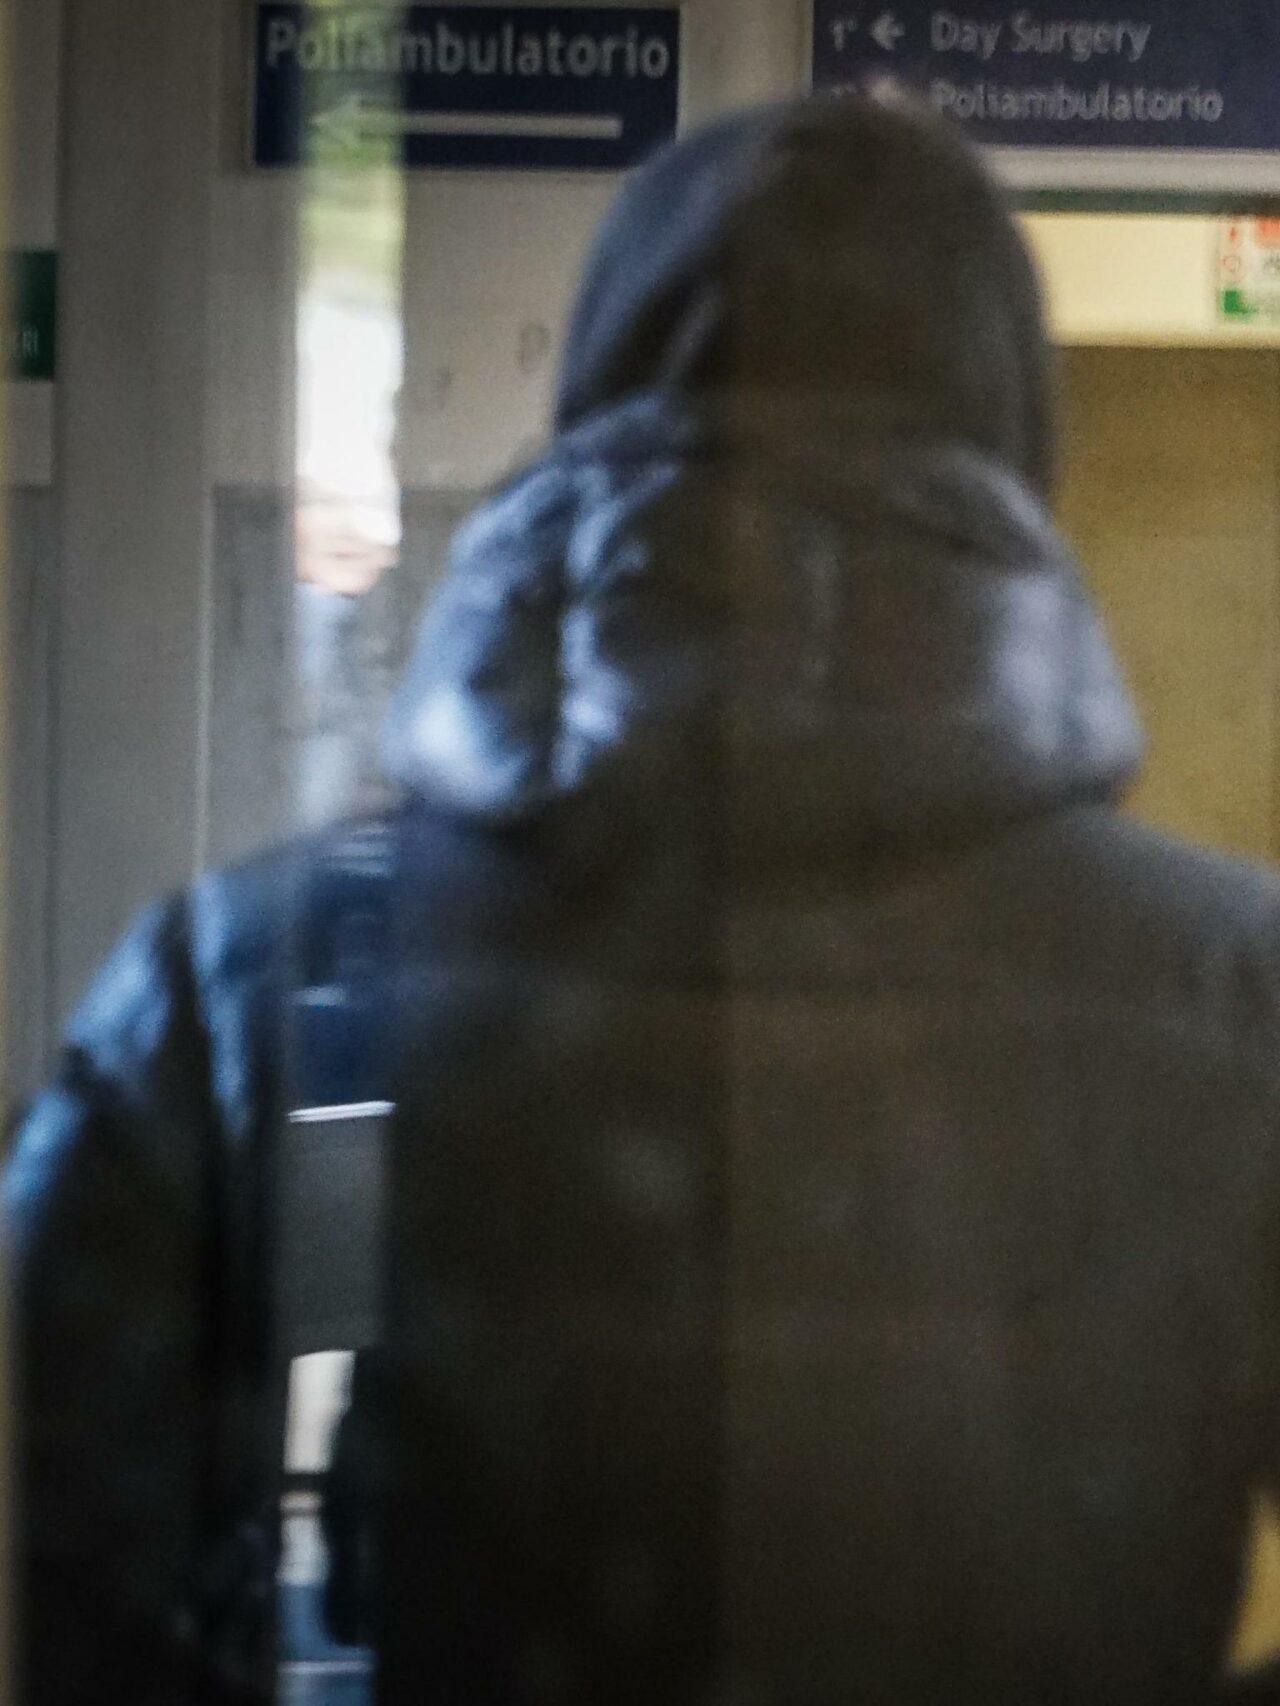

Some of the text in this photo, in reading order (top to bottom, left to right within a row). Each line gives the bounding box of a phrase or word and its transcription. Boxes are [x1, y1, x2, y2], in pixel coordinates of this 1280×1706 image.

[265, 17, 671, 79] Poliambulatorio
[930, 12, 1001, 61] Day
[1009, 10, 1152, 64] Surgery
[931, 77, 1224, 123] Poliambulatorio
